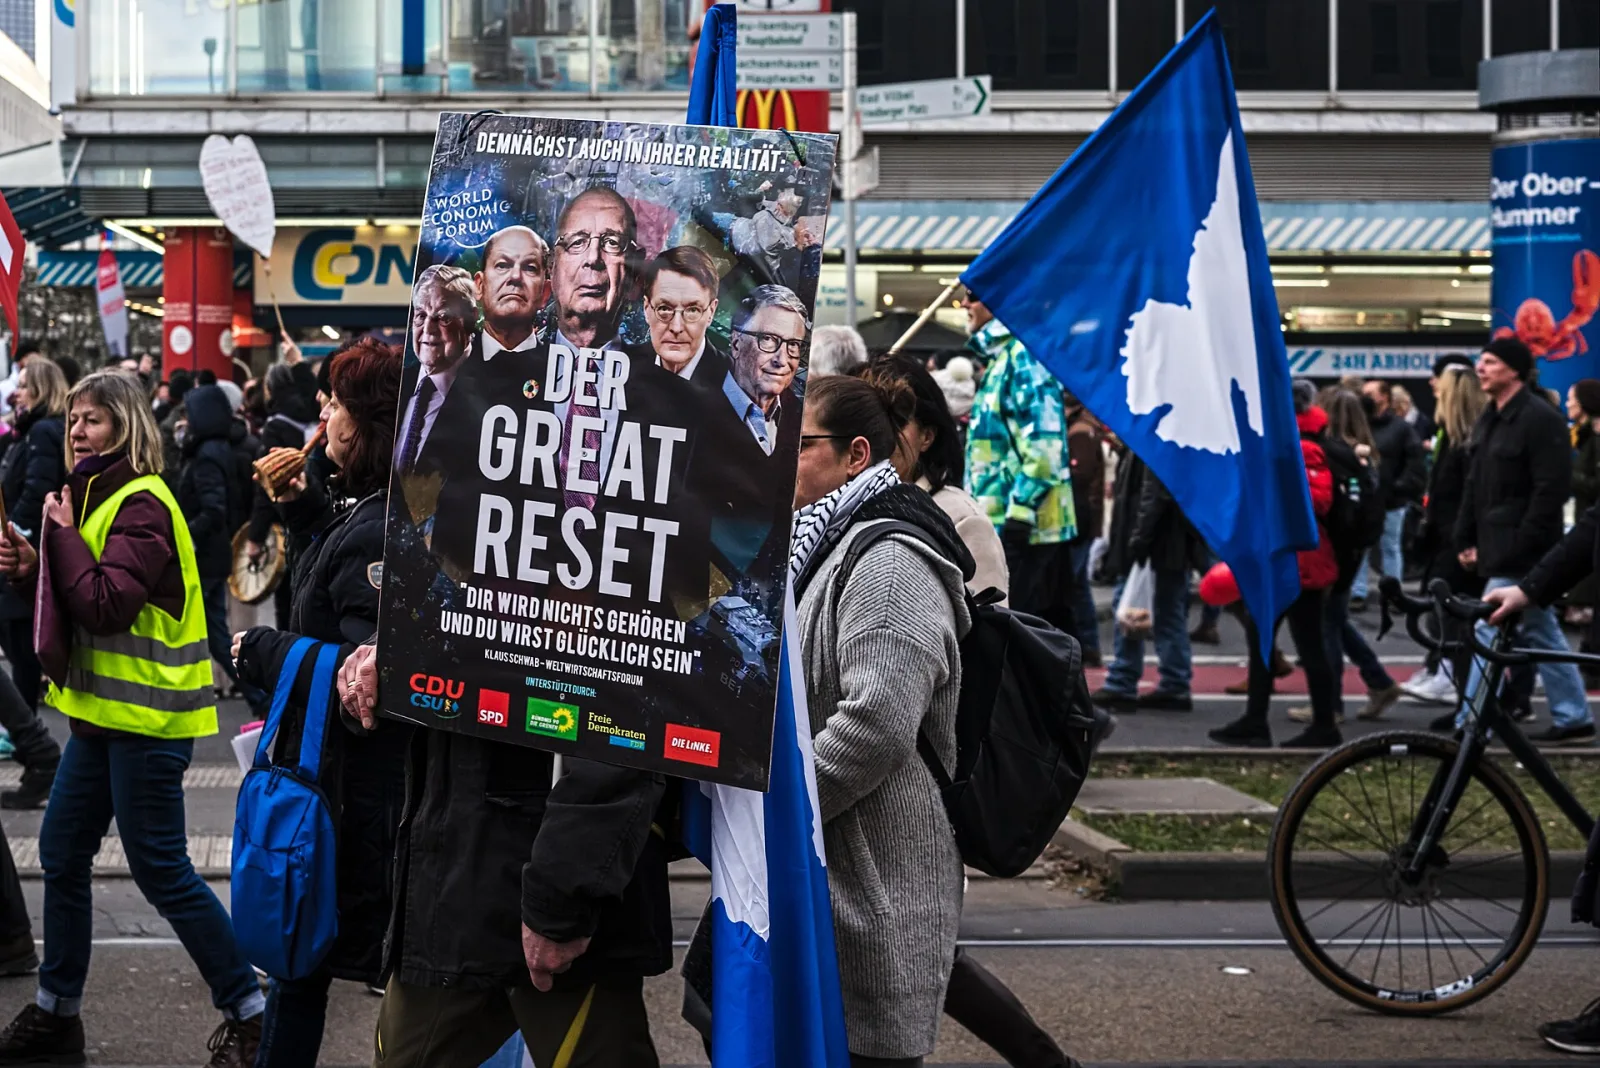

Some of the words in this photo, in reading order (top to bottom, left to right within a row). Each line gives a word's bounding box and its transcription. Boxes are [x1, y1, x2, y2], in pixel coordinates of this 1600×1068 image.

[737, 21, 809, 35] eu-Isenburg
[737, 59, 819, 69] achsenhausen
[476, 129, 577, 159] DEMNÄCHST
[578, 137, 624, 162] AUCH
[625, 141, 643, 163] IN
[644, 142, 696, 167] IHRER
[698, 144, 786, 173] REALITÄT:
[434, 188, 492, 210] WORLD
[423, 200, 510, 227] ECONOMIC
[436, 218, 494, 240] FORUM
[1331, 353, 1366, 370] 24H
[1371, 353, 1441, 370] ABHOL
[543, 343, 631, 411] DER
[478, 404, 687, 504] GREAT
[473, 493, 680, 603] RESET
[460, 581, 494, 611] "DIR
[497, 591, 540, 619] WIRD
[542, 598, 604, 630] NICHTS
[606, 608, 686, 644] GEHÖREN
[440, 610, 473, 636] UND
[475, 616, 498, 640] DU
[501, 620, 554, 650] WIRST
[556, 628, 650, 667] GLÜCKLICH
[651, 646, 702, 675] SEIN"
[484, 648, 508, 662] KLAUS
[508, 652, 540, 668] SCHWAB
[545, 659, 644, 687] WELTWIRTSCHAFTSFORUM
[409, 672, 465, 699] CDU
[525, 676, 572, 694] UNTERSTÜTZT
[410, 692, 444, 711] CSU
[479, 709, 504, 724] SPD
[588, 711, 612, 724] Freie
[587, 721, 646, 740] Demokraten
[671, 737, 686, 749] DIE
